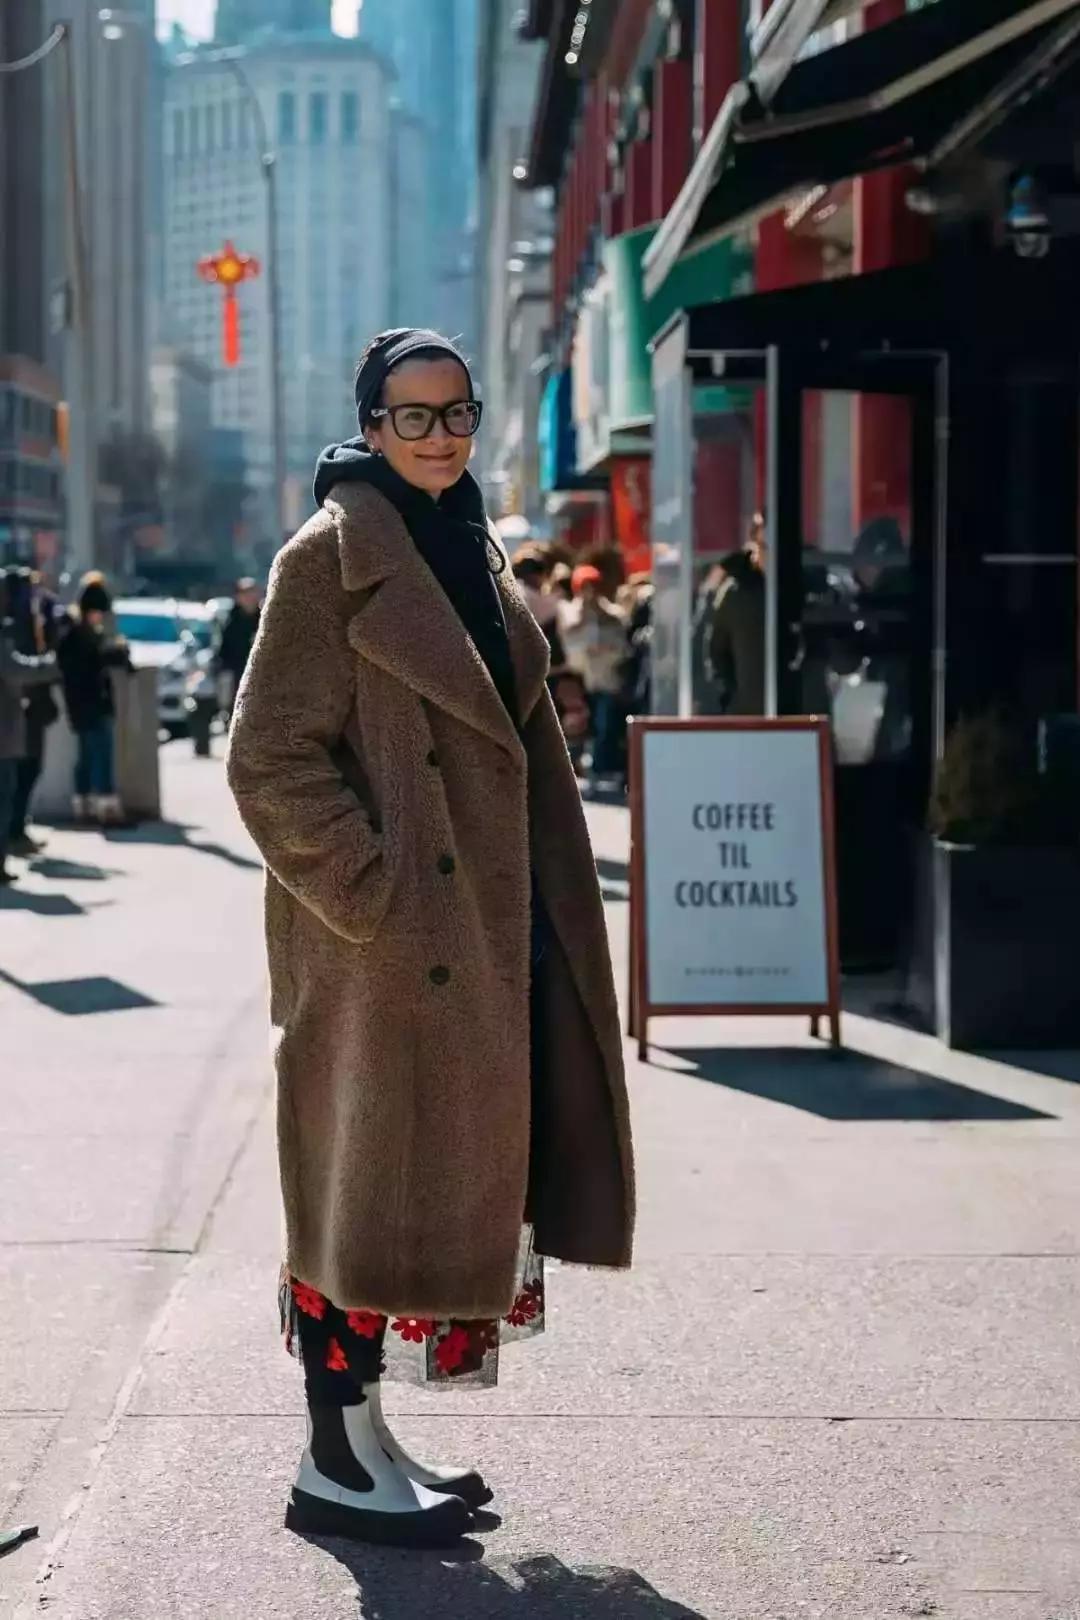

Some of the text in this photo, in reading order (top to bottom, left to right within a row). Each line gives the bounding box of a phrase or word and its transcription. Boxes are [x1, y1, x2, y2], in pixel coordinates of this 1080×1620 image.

[692, 803, 774, 831] COFFEE
[717, 842, 751, 869] TIL
[675, 880, 798, 908] COCKTAILS
